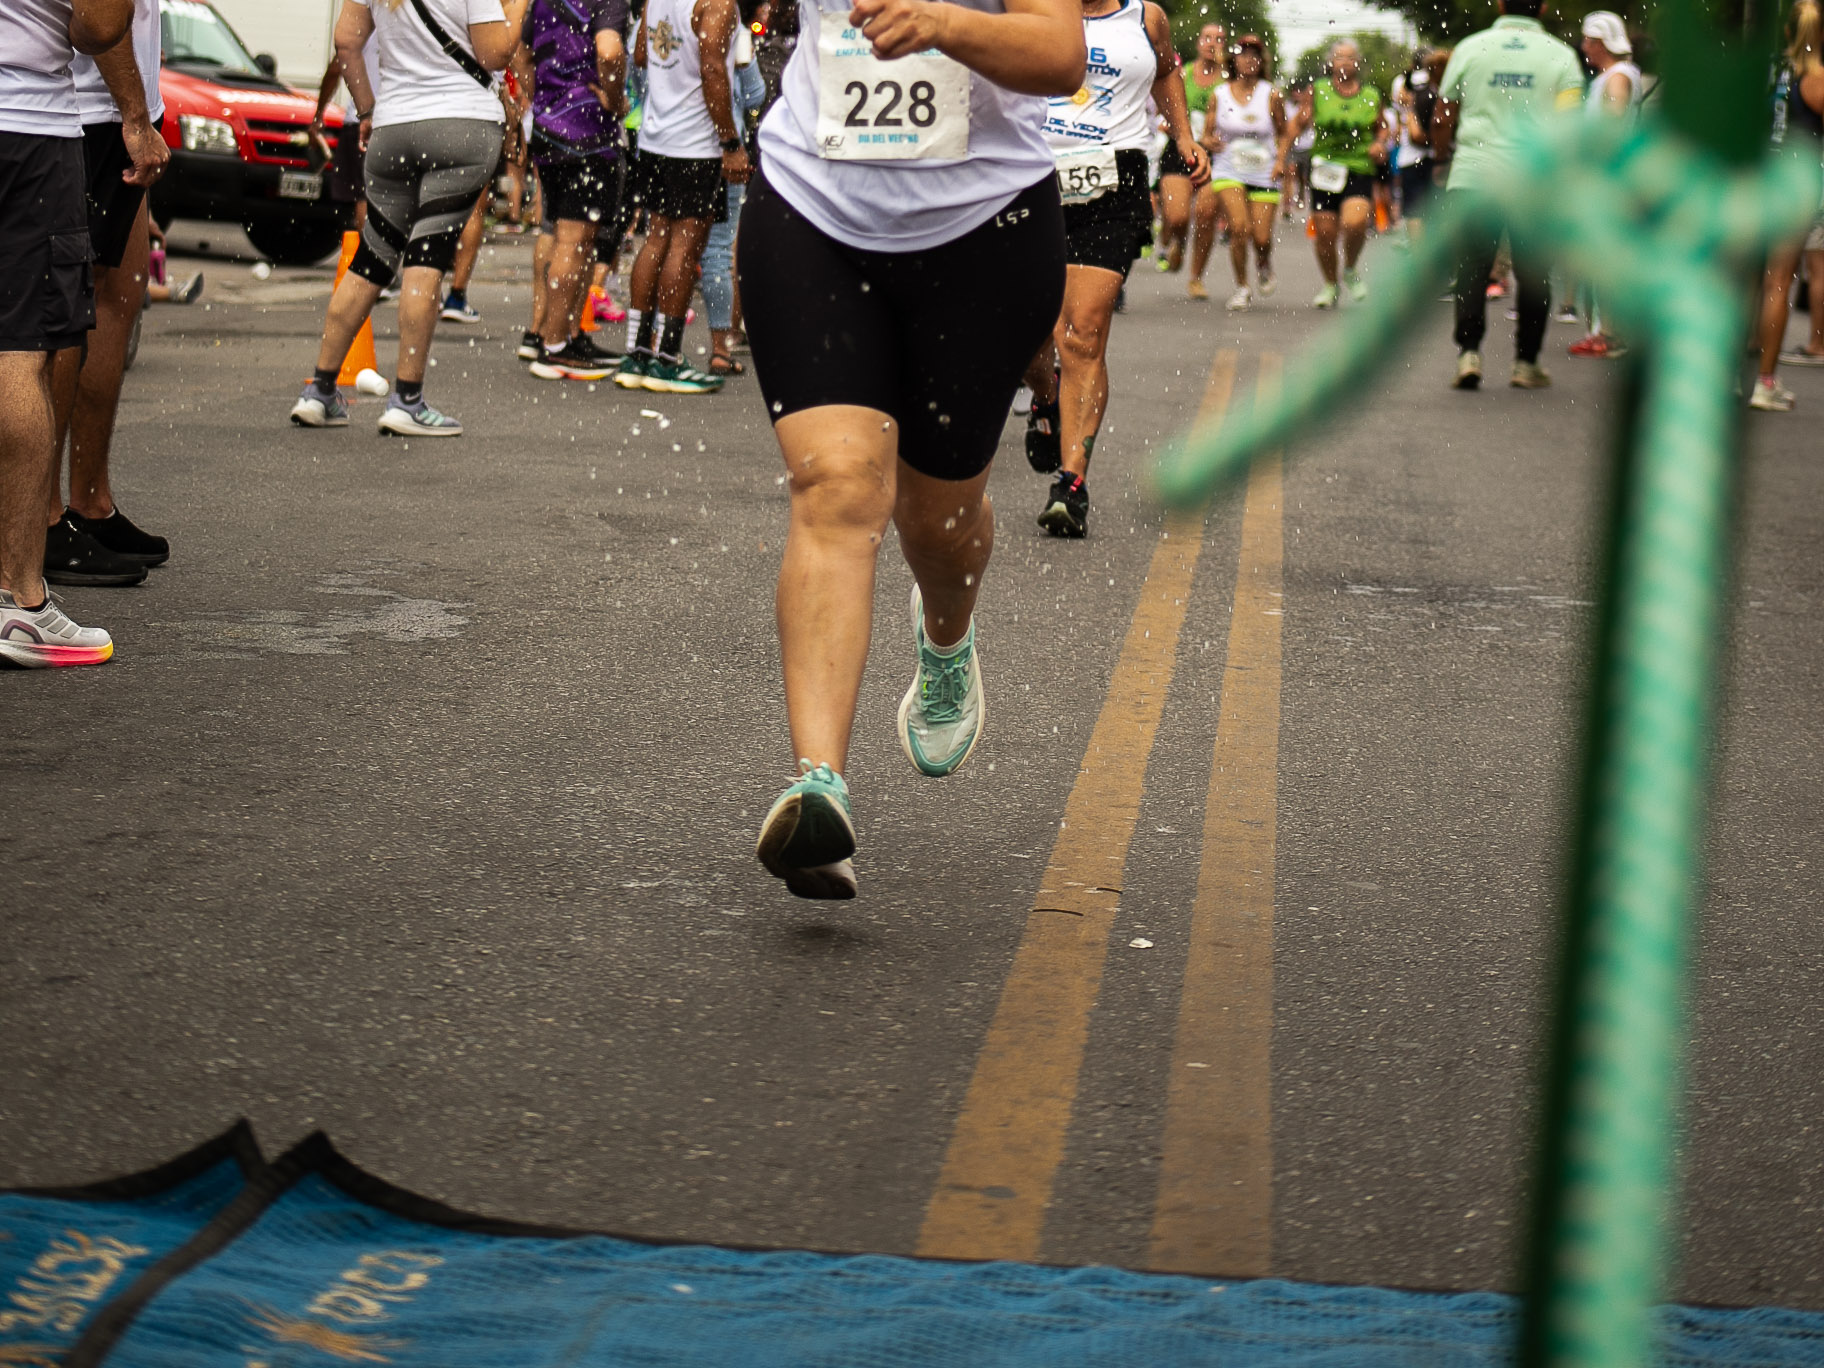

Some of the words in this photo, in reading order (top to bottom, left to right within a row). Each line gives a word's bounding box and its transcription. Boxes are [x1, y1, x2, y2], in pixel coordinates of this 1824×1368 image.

[841, 28, 856, 40] 40
[1488, 72, 1535, 89] JUEZ
[844, 80, 937, 128] 228
[872, 134, 886, 144] DEL
[1056, 165, 1101, 193] 156
